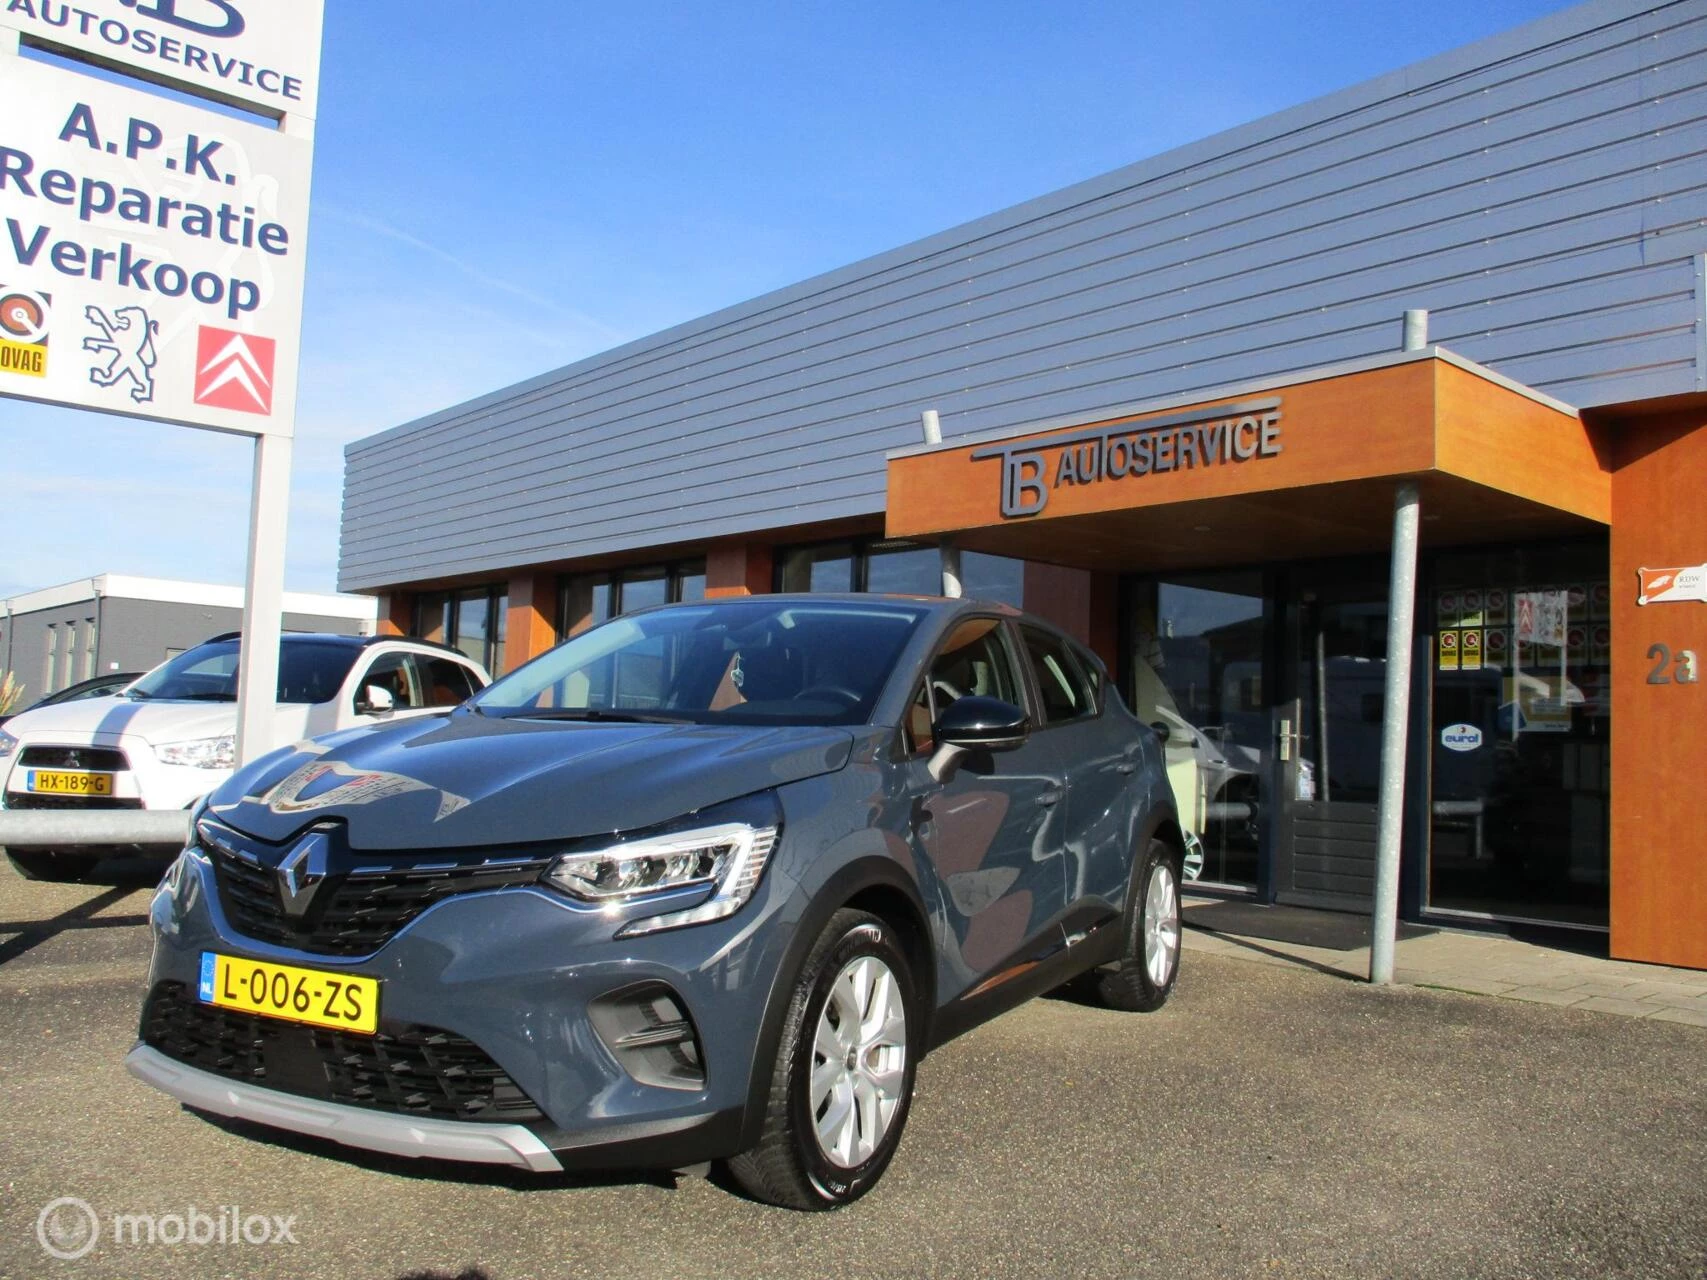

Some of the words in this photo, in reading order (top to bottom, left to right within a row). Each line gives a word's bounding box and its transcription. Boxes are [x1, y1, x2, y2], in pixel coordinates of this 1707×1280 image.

[7, 0, 302, 100] AUTOSERVICE
[59, 102, 236, 186] A.P.K.
[0, 145, 289, 255] Reparatie
[6, 218, 260, 320] Verkoop
[1056, 411, 1282, 484] AUTOSERVICE
[1647, 643, 1698, 684] 2a
[40, 774, 104, 791] HX-189-G
[200, 982, 213, 994] NL
[224, 964, 362, 1021] L-006-ZS
